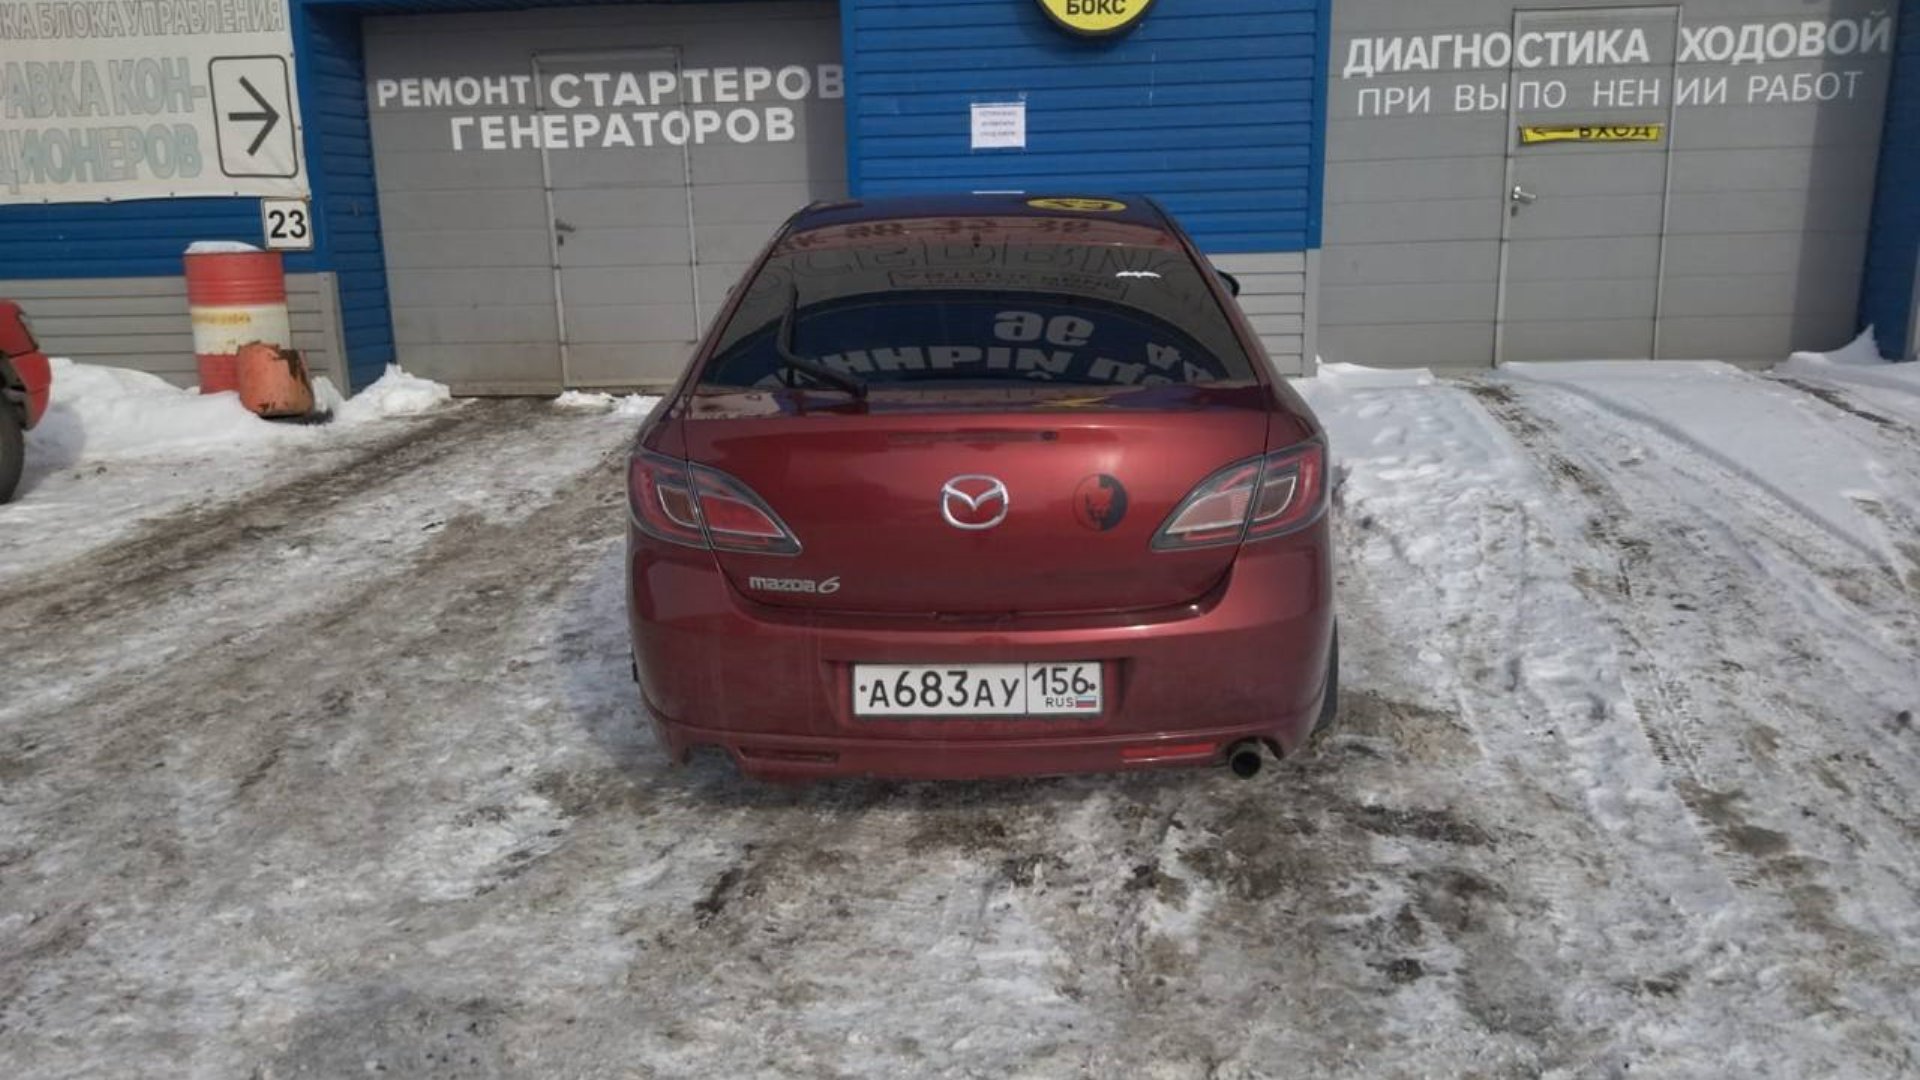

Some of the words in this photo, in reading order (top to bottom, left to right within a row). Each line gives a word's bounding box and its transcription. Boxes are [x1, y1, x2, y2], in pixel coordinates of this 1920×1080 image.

[0, 2, 40, 39] КА
[1066, 0, 1126, 15] БОКС
[1343, 28, 1650, 79] ДИАГНОСТИКА
[1679, 10, 1892, 65] ХОДОВОЙ
[0, 59, 109, 119] АВКА
[377, 75, 531, 107] РЕМОНТ
[550, 64, 845, 108] СТАРТЕРОВ
[1357, 86, 1431, 116] ПРИ
[1747, 71, 1864, 103] РАБОТ
[451, 107, 796, 150] ГЕНЕРАТОРОВ
[268, 210, 307, 239] 23
[1031, 667, 1090, 696] 156
[1045, 697, 1076, 708] RUS
